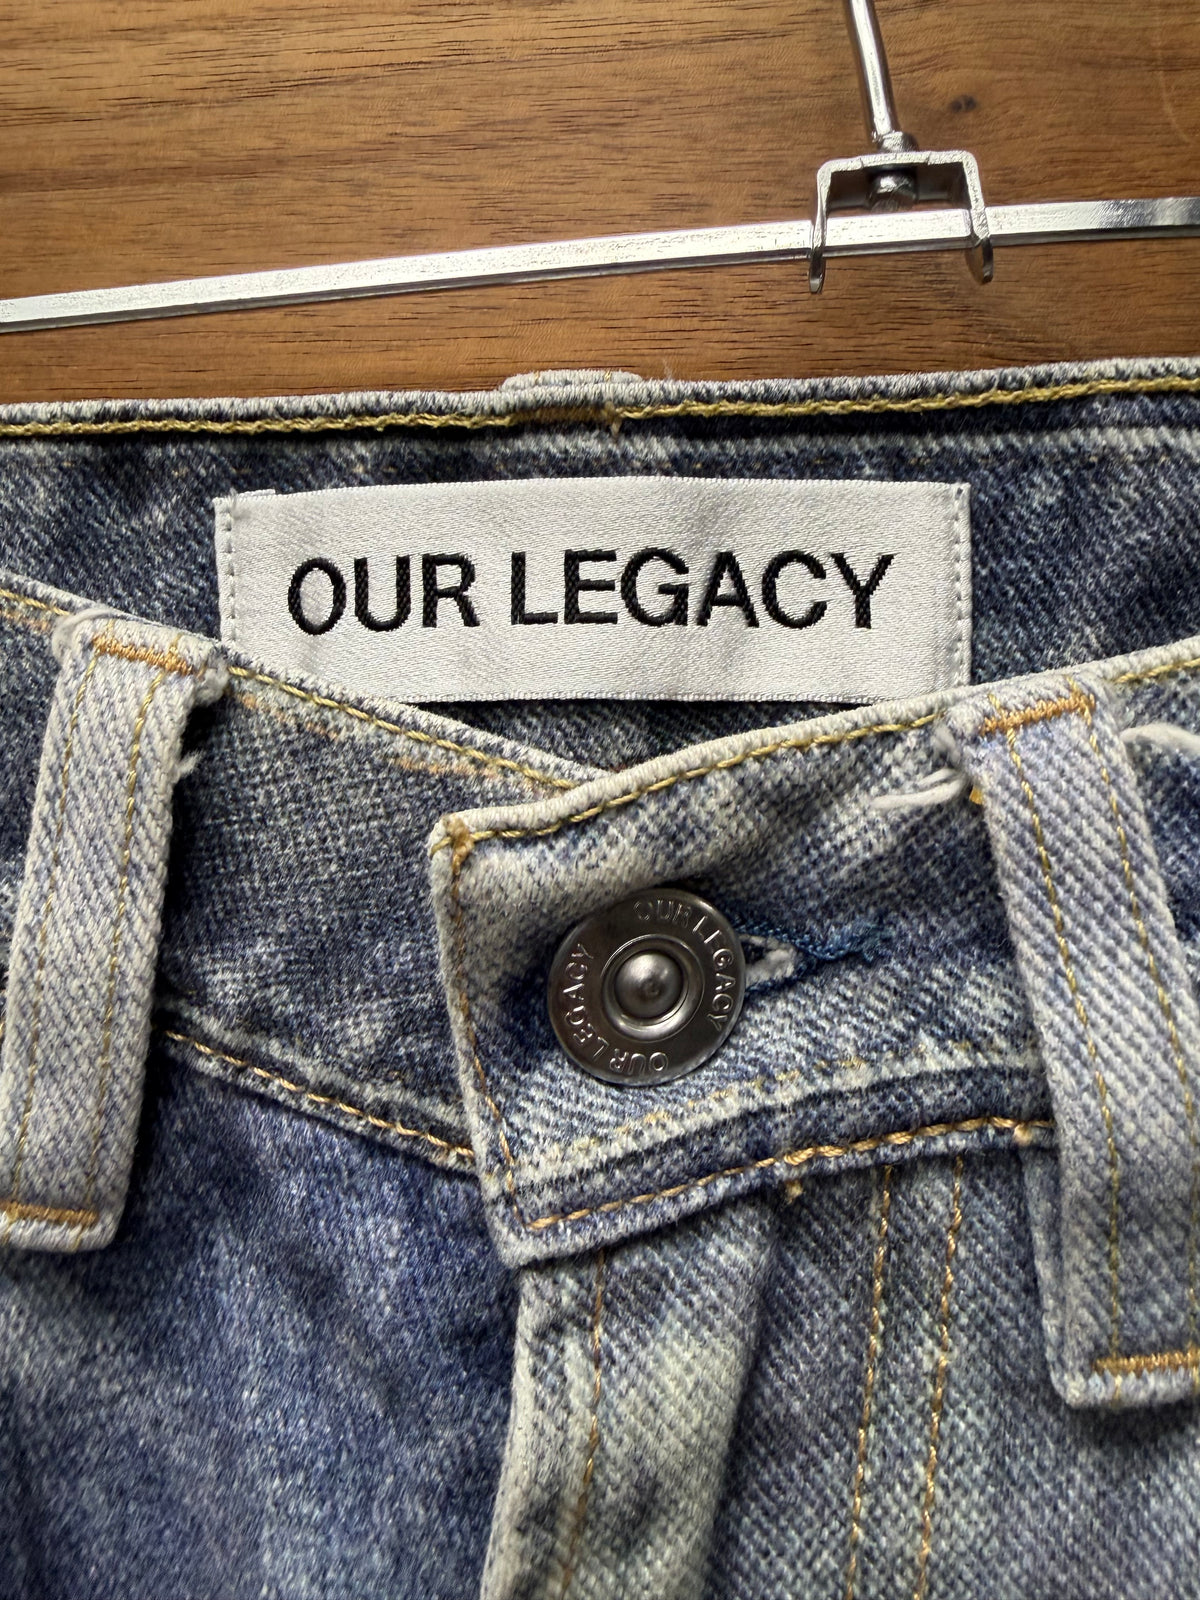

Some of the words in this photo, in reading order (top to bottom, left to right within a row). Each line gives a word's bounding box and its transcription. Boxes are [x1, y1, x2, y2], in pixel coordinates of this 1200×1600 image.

[287, 553, 481, 636] OUR
[510, 547, 897, 630] LEGACY
[562, 943, 610, 1062] LEGACY
[633, 899, 693, 928] OUR
[692, 915, 737, 1032] LEGACY
[609, 1048, 669, 1076] OUR
